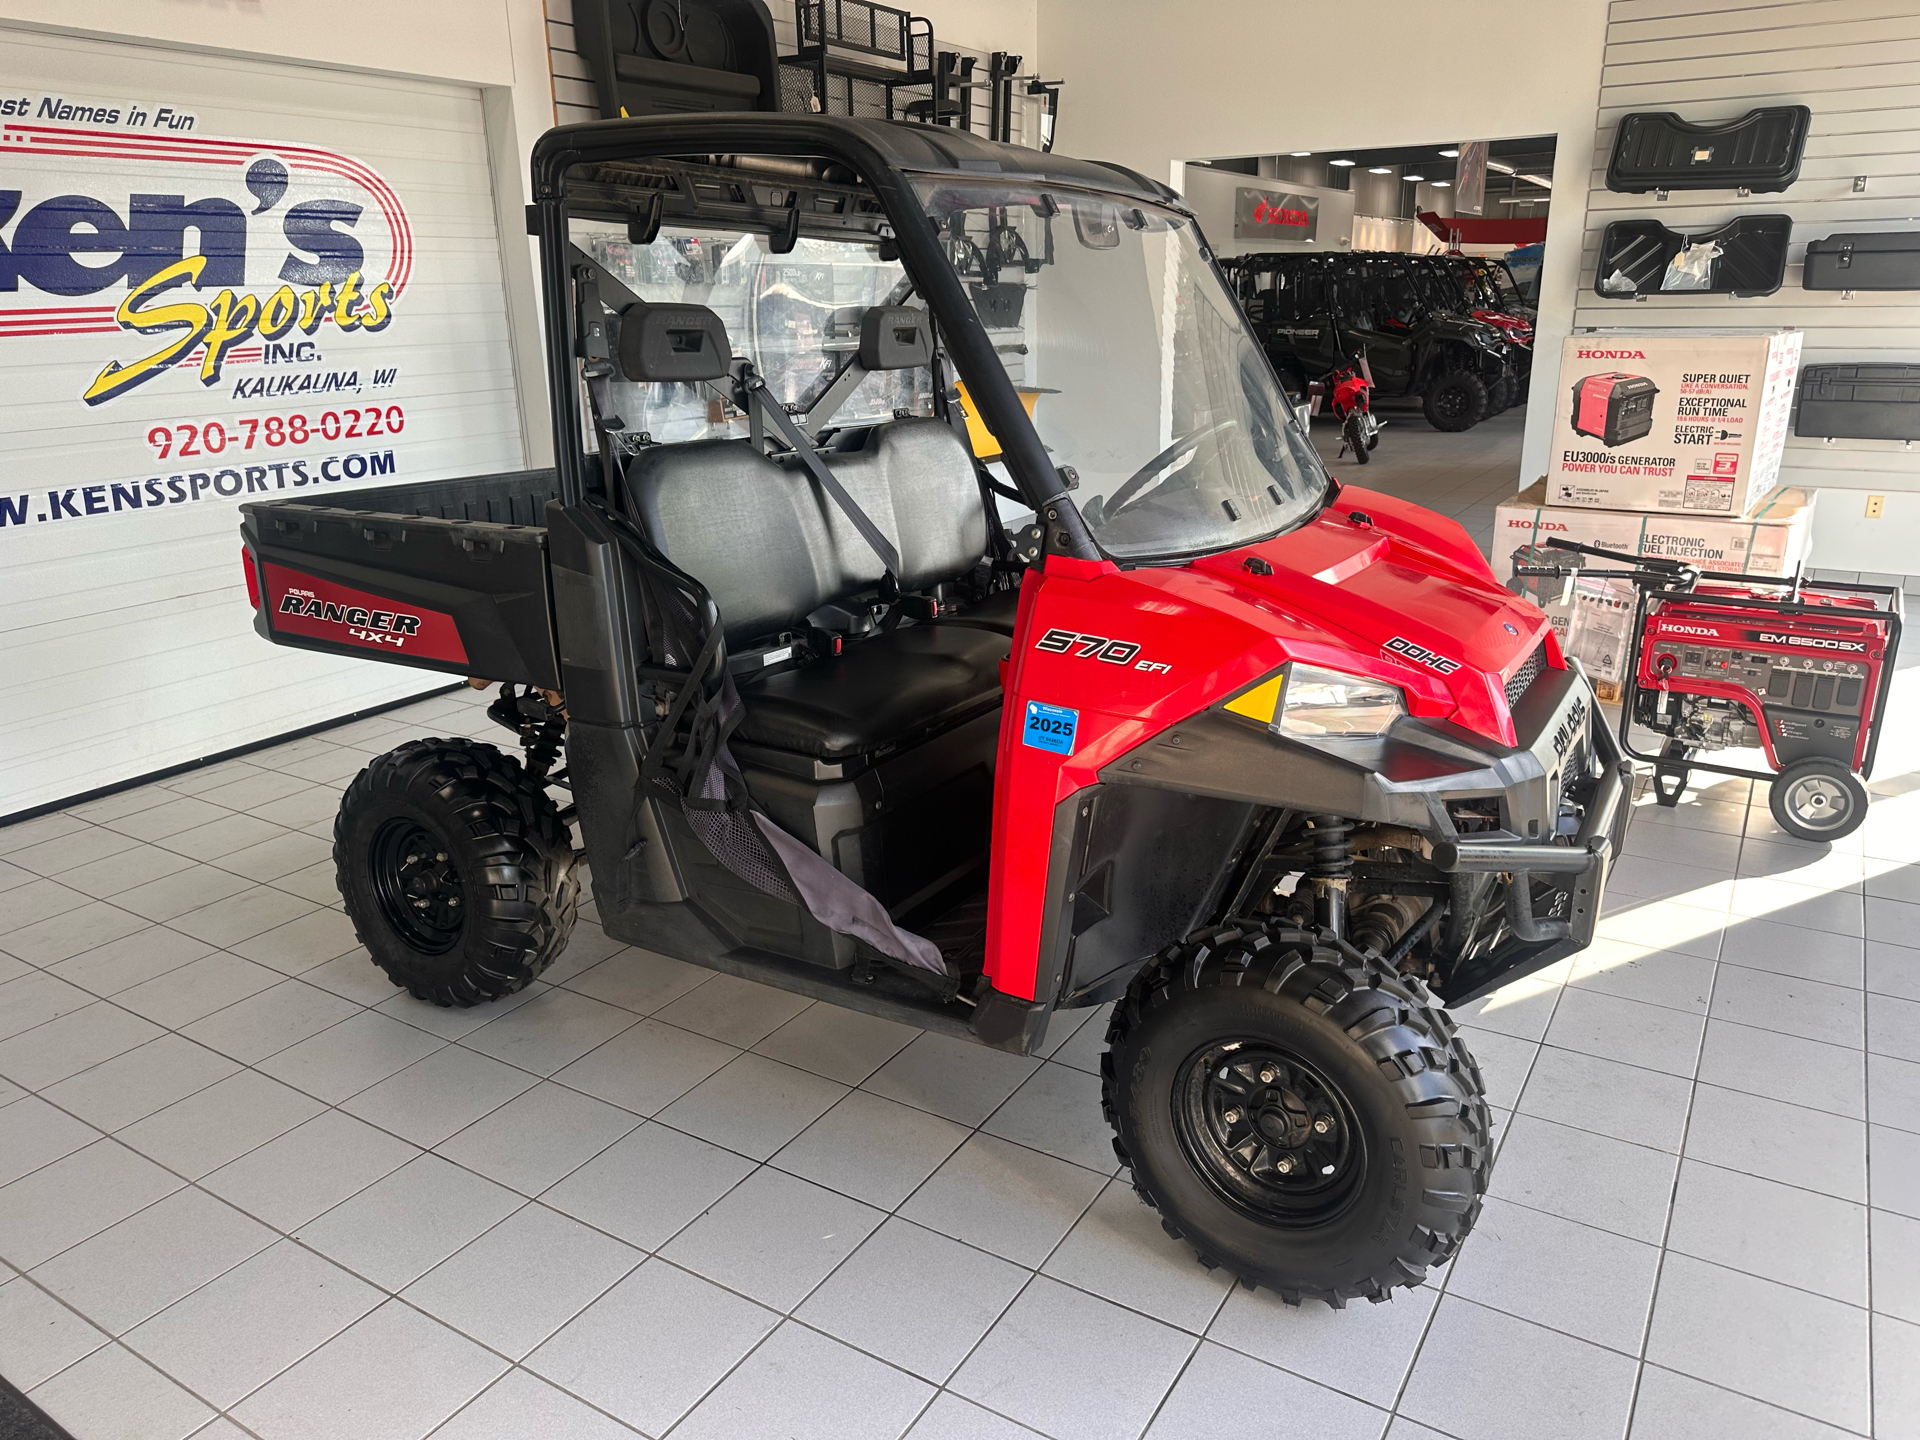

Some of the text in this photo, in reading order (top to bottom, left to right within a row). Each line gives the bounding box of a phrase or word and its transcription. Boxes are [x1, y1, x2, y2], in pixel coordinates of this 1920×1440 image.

[37, 97, 120, 124] Names
[126, 106, 147, 126] in
[153, 108, 195, 131] Fun
[1267, 206, 1309, 227] HONDA
[655, 315, 714, 326] RANGER
[888, 315, 923, 325] RANGER
[84, 256, 394, 406] Sports
[1276, 328, 1320, 336] PIONEER
[263, 341, 322, 365] INC.
[1576, 350, 1646, 360] HONDA
[232, 368, 398, 400] KAUKAUNA, WI
[1627, 381, 1649, 390] HONDA
[1682, 373, 1751, 384] SUPER QUIET
[1700, 383, 1749, 391] CONVERSATION,
[1679, 397, 1748, 408] EXCEPTIONAL
[1677, 407, 1728, 417] RUN TIME
[147, 405, 405, 460] 920-788-0220
[1675, 425, 1714, 434] ELECTRIC
[1673, 433, 1713, 445] START
[1563, 450, 1676, 467] EU3000is GENERATOR
[1562, 463, 1675, 477] POWER YOU CAN TRUST
[1601, 541, 1629, 550] Bluetooth
[1666, 546, 1724, 560] INJECTION
[288, 587, 315, 598] POLARIS
[279, 594, 421, 637] RANGER
[1660, 623, 1719, 637] HONDA
[1034, 628, 1172, 675] 570 EFI
[1382, 635, 1463, 676] DOHC
[1029, 715, 1073, 737] 2025
[1553, 696, 1586, 767] POLARIS
[1371, 1136, 1407, 1248] CARLSTAR
